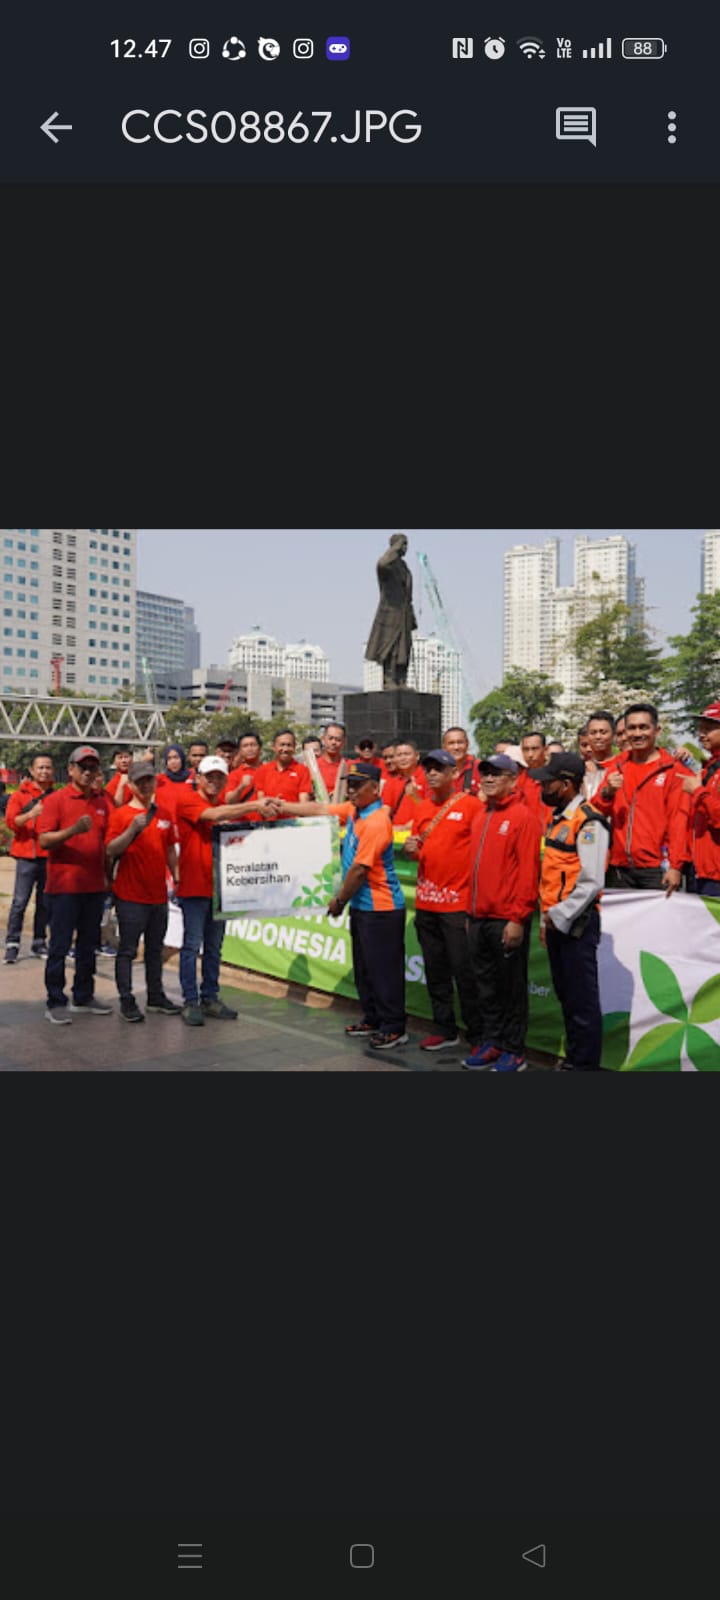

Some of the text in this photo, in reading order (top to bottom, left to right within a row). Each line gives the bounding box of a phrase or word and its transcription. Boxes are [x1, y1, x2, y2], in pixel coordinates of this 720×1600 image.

[226, 861, 279, 874] Peralatan
[226, 873, 291, 887] Kebersihan
[225, 918, 347, 965] INDONESIA
